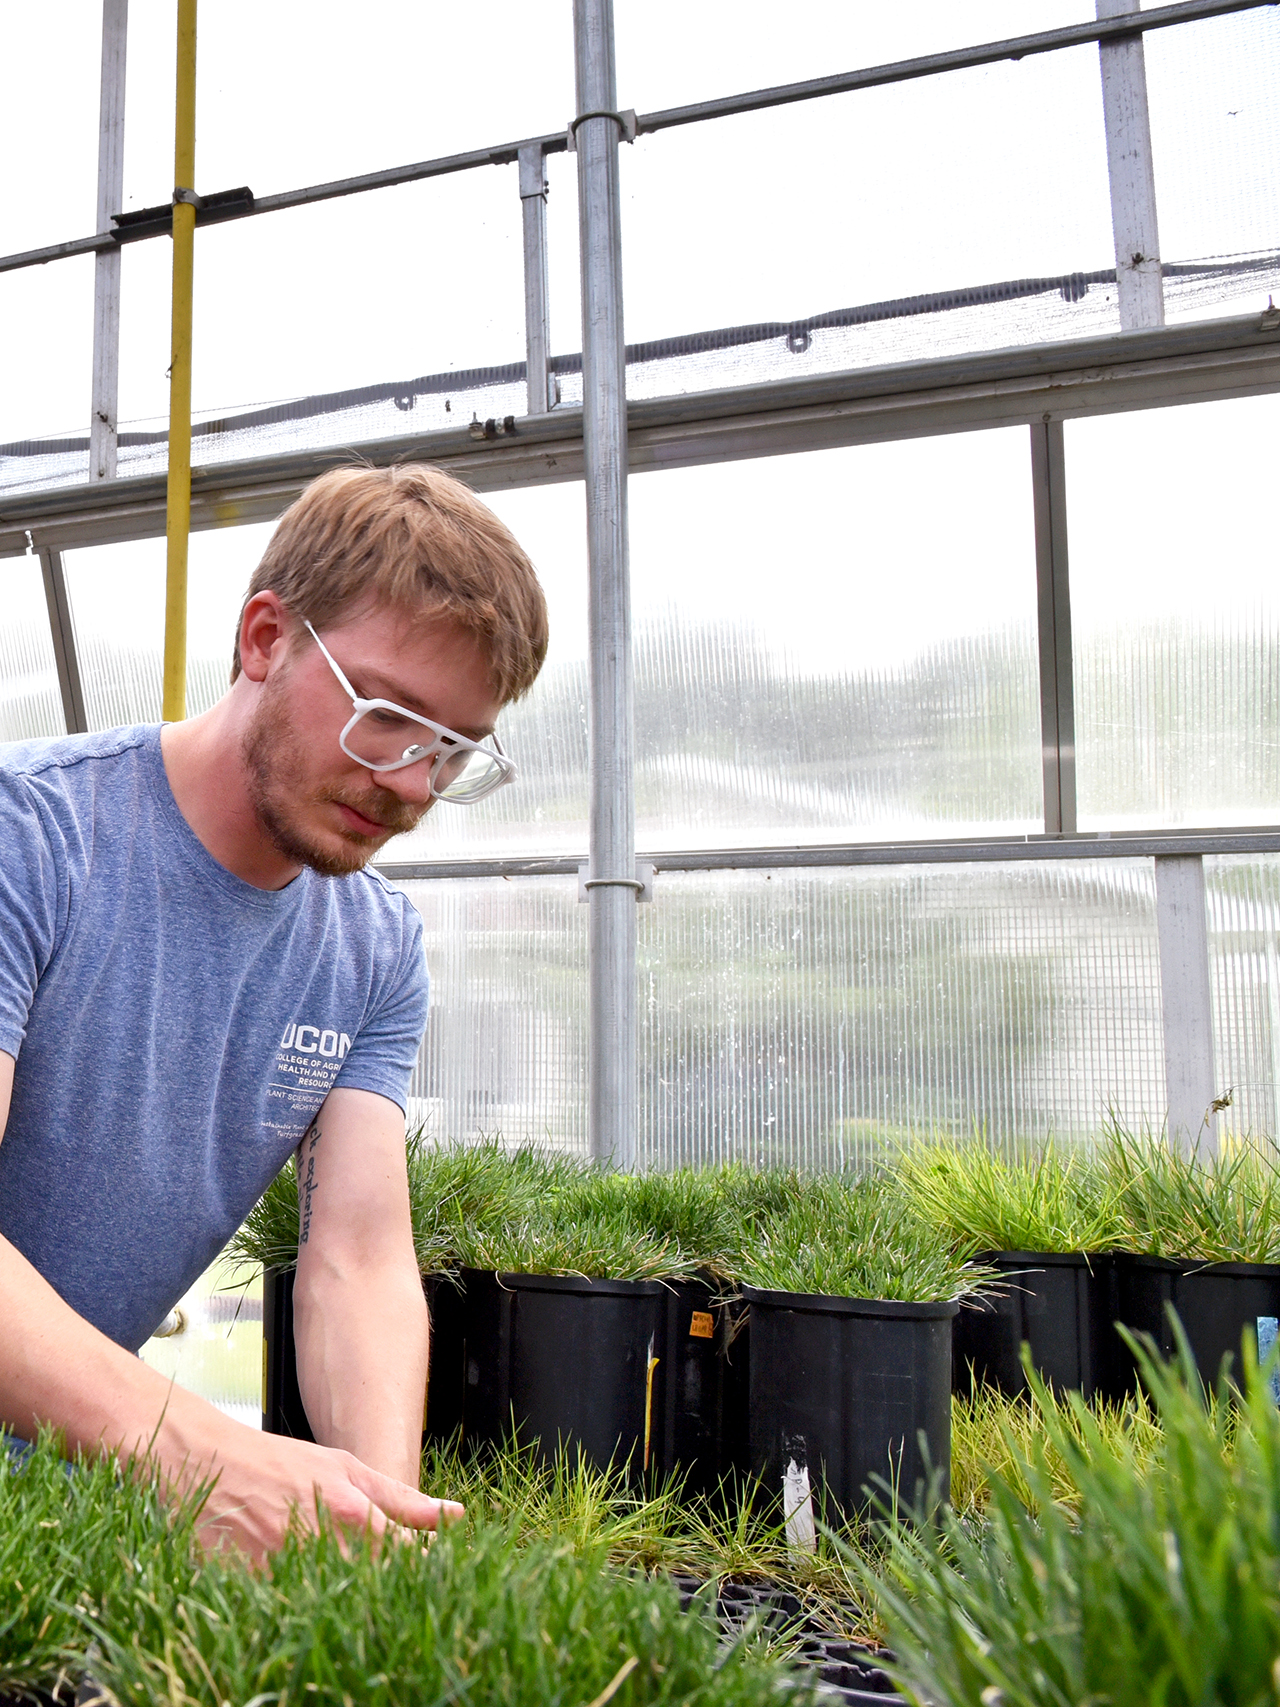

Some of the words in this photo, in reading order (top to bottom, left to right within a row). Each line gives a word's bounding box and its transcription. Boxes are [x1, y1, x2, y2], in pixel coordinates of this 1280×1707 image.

[276, 1053, 309, 1066] COLLEGE
[310, 1059, 322, 1068] OF
[277, 1063, 310, 1076] HEALTH
[311, 1070, 329, 1079] AND
[265, 1089, 287, 1098] PLANT
[287, 1093, 314, 1103] SCIENCE
[300, 1156, 318, 1246] exploring
